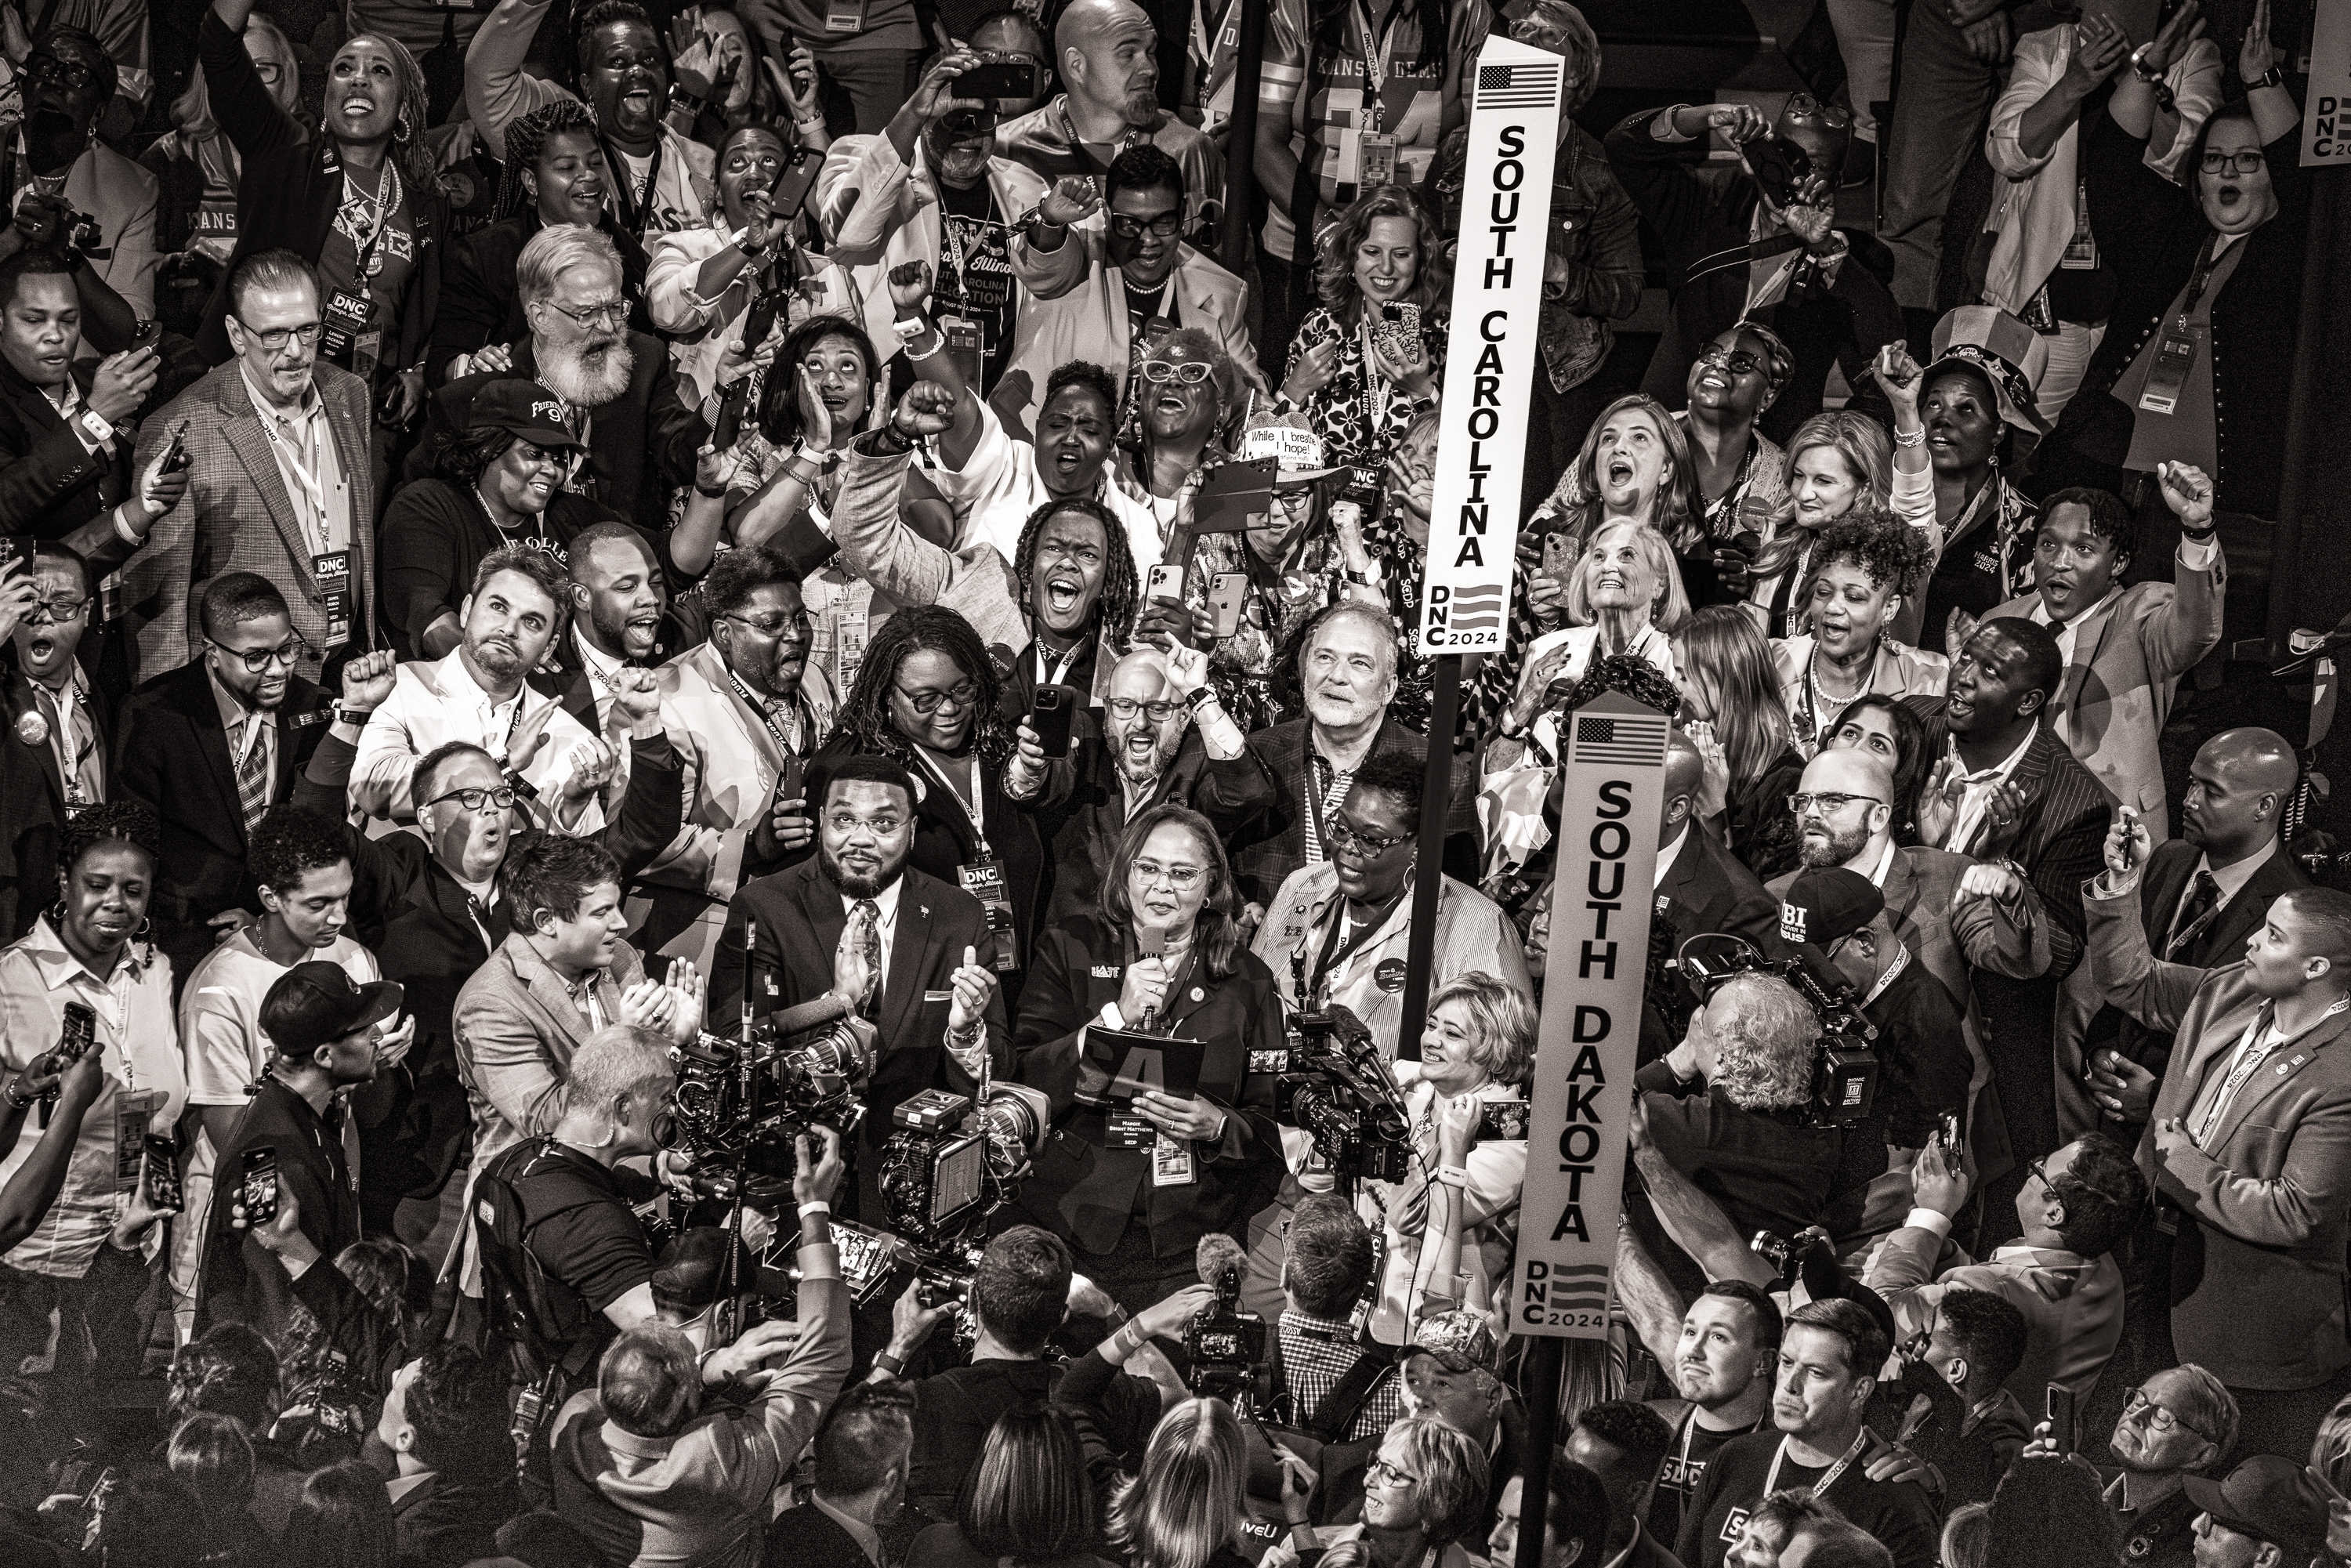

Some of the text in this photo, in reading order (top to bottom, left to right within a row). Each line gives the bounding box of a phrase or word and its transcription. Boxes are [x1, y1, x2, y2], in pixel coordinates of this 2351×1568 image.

[2313, 96, 2337, 158] DNC
[970, 255, 1014, 274] Illino
[333, 295, 366, 316] DNC
[324, 335, 345, 346] JACKSON
[1454, 125, 1526, 567] SOUTH CAROLINA
[1368, 374, 1377, 391] DNC
[1252, 429, 1275, 442] While
[1281, 430, 1284, 441] I
[1277, 441, 1310, 455] I hope!
[319, 559, 344, 573] DNC
[1973, 559, 1996, 574] 2024
[1974, 551, 1999, 567] HARRIS
[1400, 578, 1415, 608] SCDP
[1426, 585, 1450, 646] DNC
[1449, 632, 1498, 646] 2024
[965, 868, 997, 884] DNC
[1378, 971, 1405, 980] Breathe
[1881, 968, 1896, 986] 2024
[1549, 780, 1632, 1243] SOUTH DAKOTA
[2227, 1052, 2263, 1089] DNC 2024
[1523, 1260, 1549, 1324] DNC
[1549, 1313, 1603, 1327] 2024
